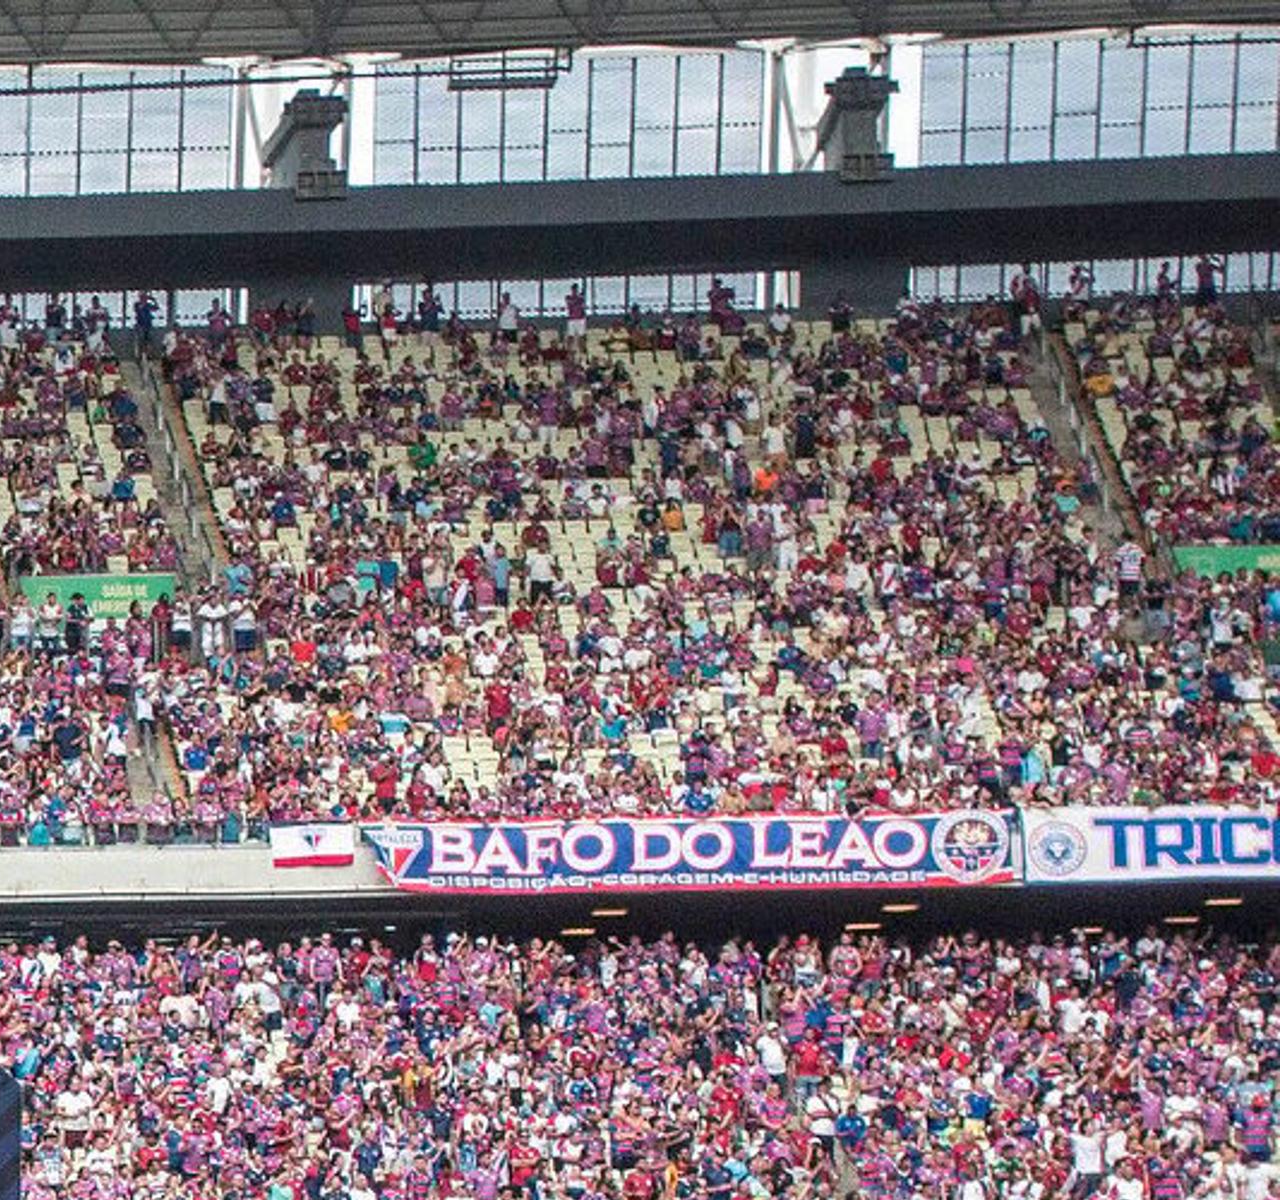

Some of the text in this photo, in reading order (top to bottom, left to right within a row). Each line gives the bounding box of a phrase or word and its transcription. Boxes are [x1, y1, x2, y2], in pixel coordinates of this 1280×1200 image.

[427, 822, 617, 874] BAFO
[630, 820, 735, 872] DO
[1094, 816, 1280, 869] TRIC
